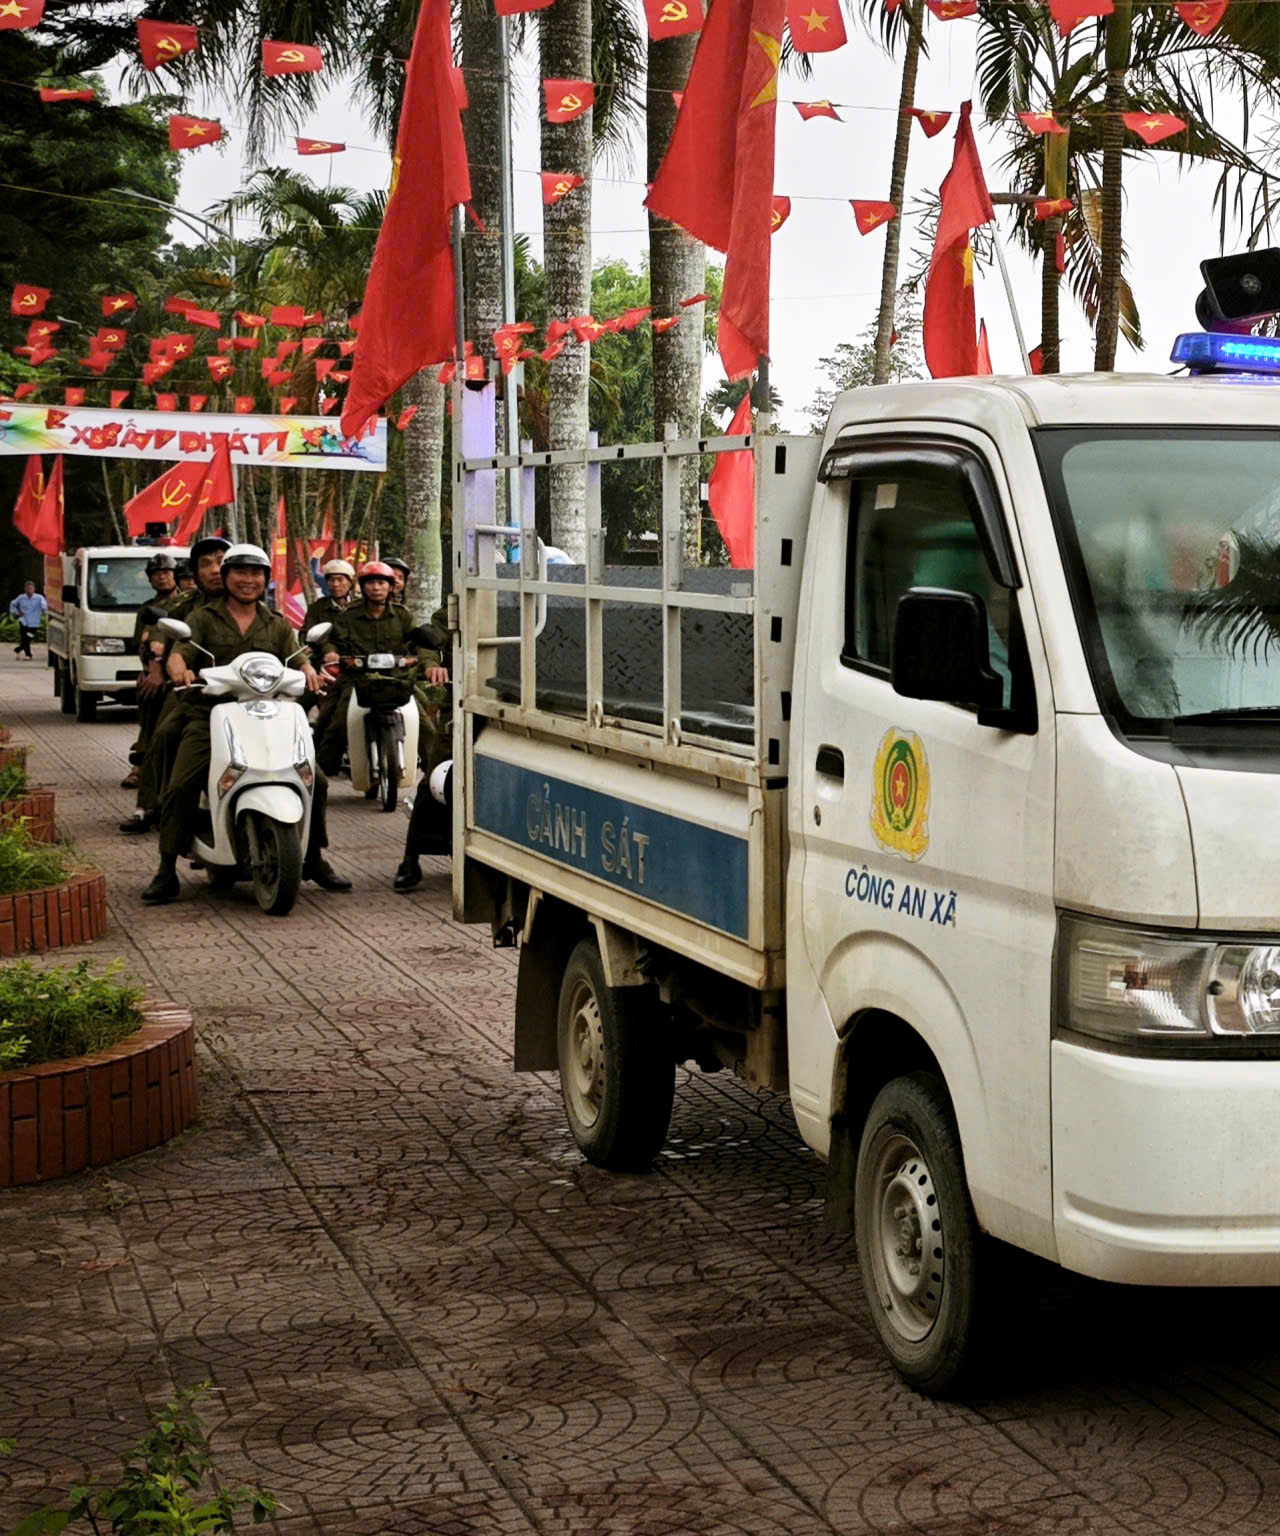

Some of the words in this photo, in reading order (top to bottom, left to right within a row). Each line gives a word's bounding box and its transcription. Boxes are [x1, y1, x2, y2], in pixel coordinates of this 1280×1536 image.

[70, 418, 171, 449] XẤ
[526, 782, 587, 858] CẢNH
[601, 815, 649, 884] SÁT
[845, 864, 895, 909] CÔNG
[898, 884, 927, 918] AN
[929, 890, 957, 928] XÃ
